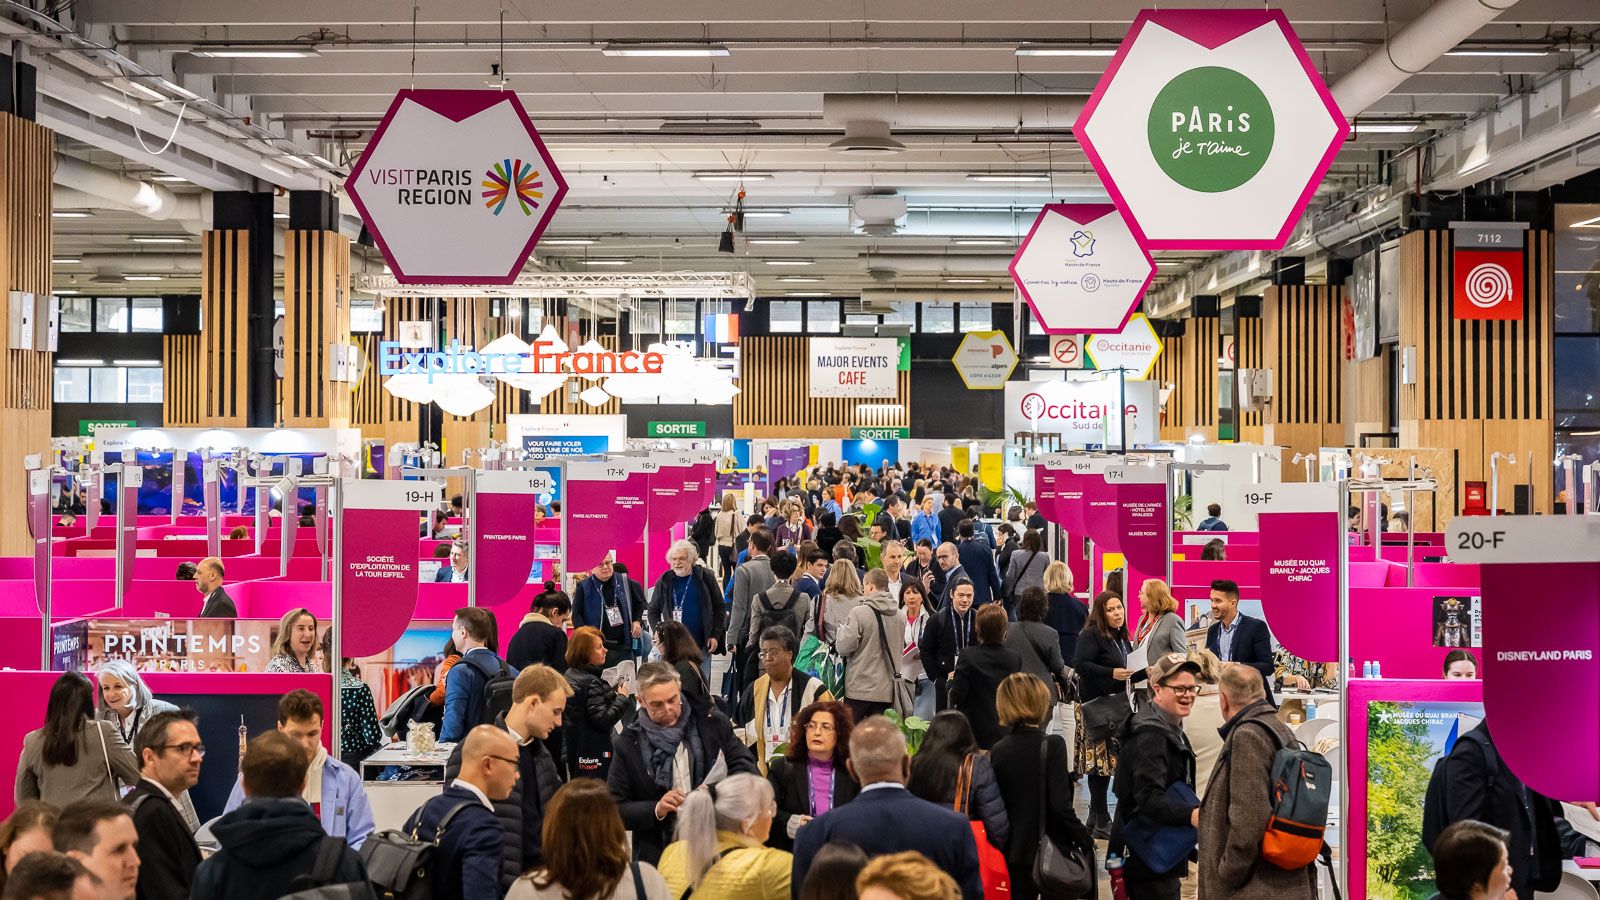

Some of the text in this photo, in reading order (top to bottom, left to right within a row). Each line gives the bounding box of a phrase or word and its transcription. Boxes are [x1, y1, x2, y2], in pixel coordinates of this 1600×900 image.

[1172, 137, 1194, 160] je
[398, 188, 472, 206] REGION
[1477, 233, 1502, 244] 7112
[1096, 339, 1152, 352] Occitanie
[379, 338, 664, 384] Explore France
[817, 355, 888, 368] MAJOR EVENTS
[838, 371, 867, 385] CAFE
[656, 423, 698, 434] SORTIE
[1072, 421, 1090, 430] Sud
[859, 429, 900, 439] SORTIE
[606, 468, 625, 476] 17-K
[528, 479, 546, 488] 18-I
[405, 491, 434, 503] 19-H
[1244, 492, 1273, 505] 19-F
[1457, 530, 1506, 550] 20-F
[366, 554, 395, 564] SOCIÉTÉ
[1273, 558, 1326, 567] MUSÉE DU QUAI
[350, 563, 400, 571] D'EXPLOITATION
[1269, 566, 1295, 575] BRANLY
[1299, 566, 1331, 575] JACQUES
[383, 571, 405, 579] EIFFEL
[53, 636, 80, 655] PRINTEMPS
[104, 633, 262, 654] PRINTEMPS
[1496, 649, 1593, 662] DISNEYLAND PARIS
[159, 659, 206, 670] PARIS
[1393, 711, 1414, 719] MUSÉE
[1393, 718, 1421, 726] JACQUES
[578, 756, 599, 764] Explore
